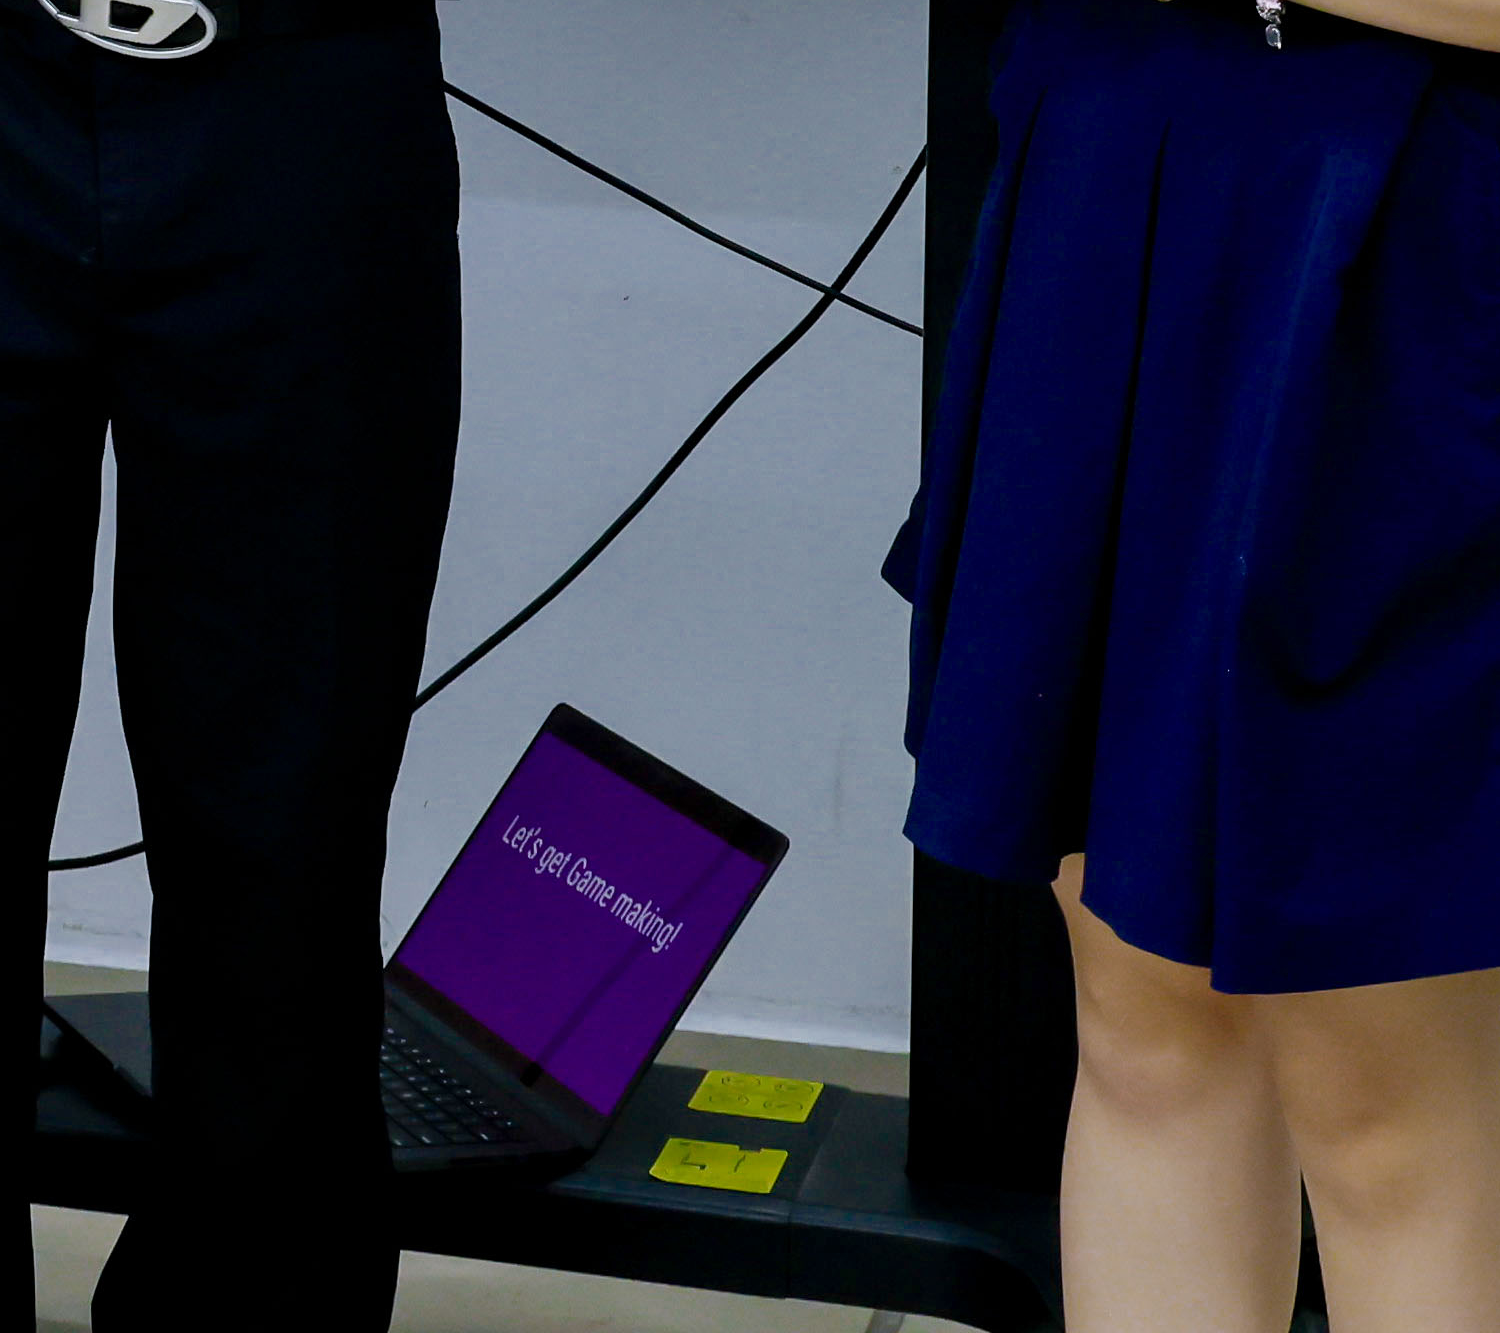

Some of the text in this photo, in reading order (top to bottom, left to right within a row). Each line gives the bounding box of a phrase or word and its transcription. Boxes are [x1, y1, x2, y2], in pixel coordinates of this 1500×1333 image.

[502, 814, 684, 953] Let’s get Game making!
